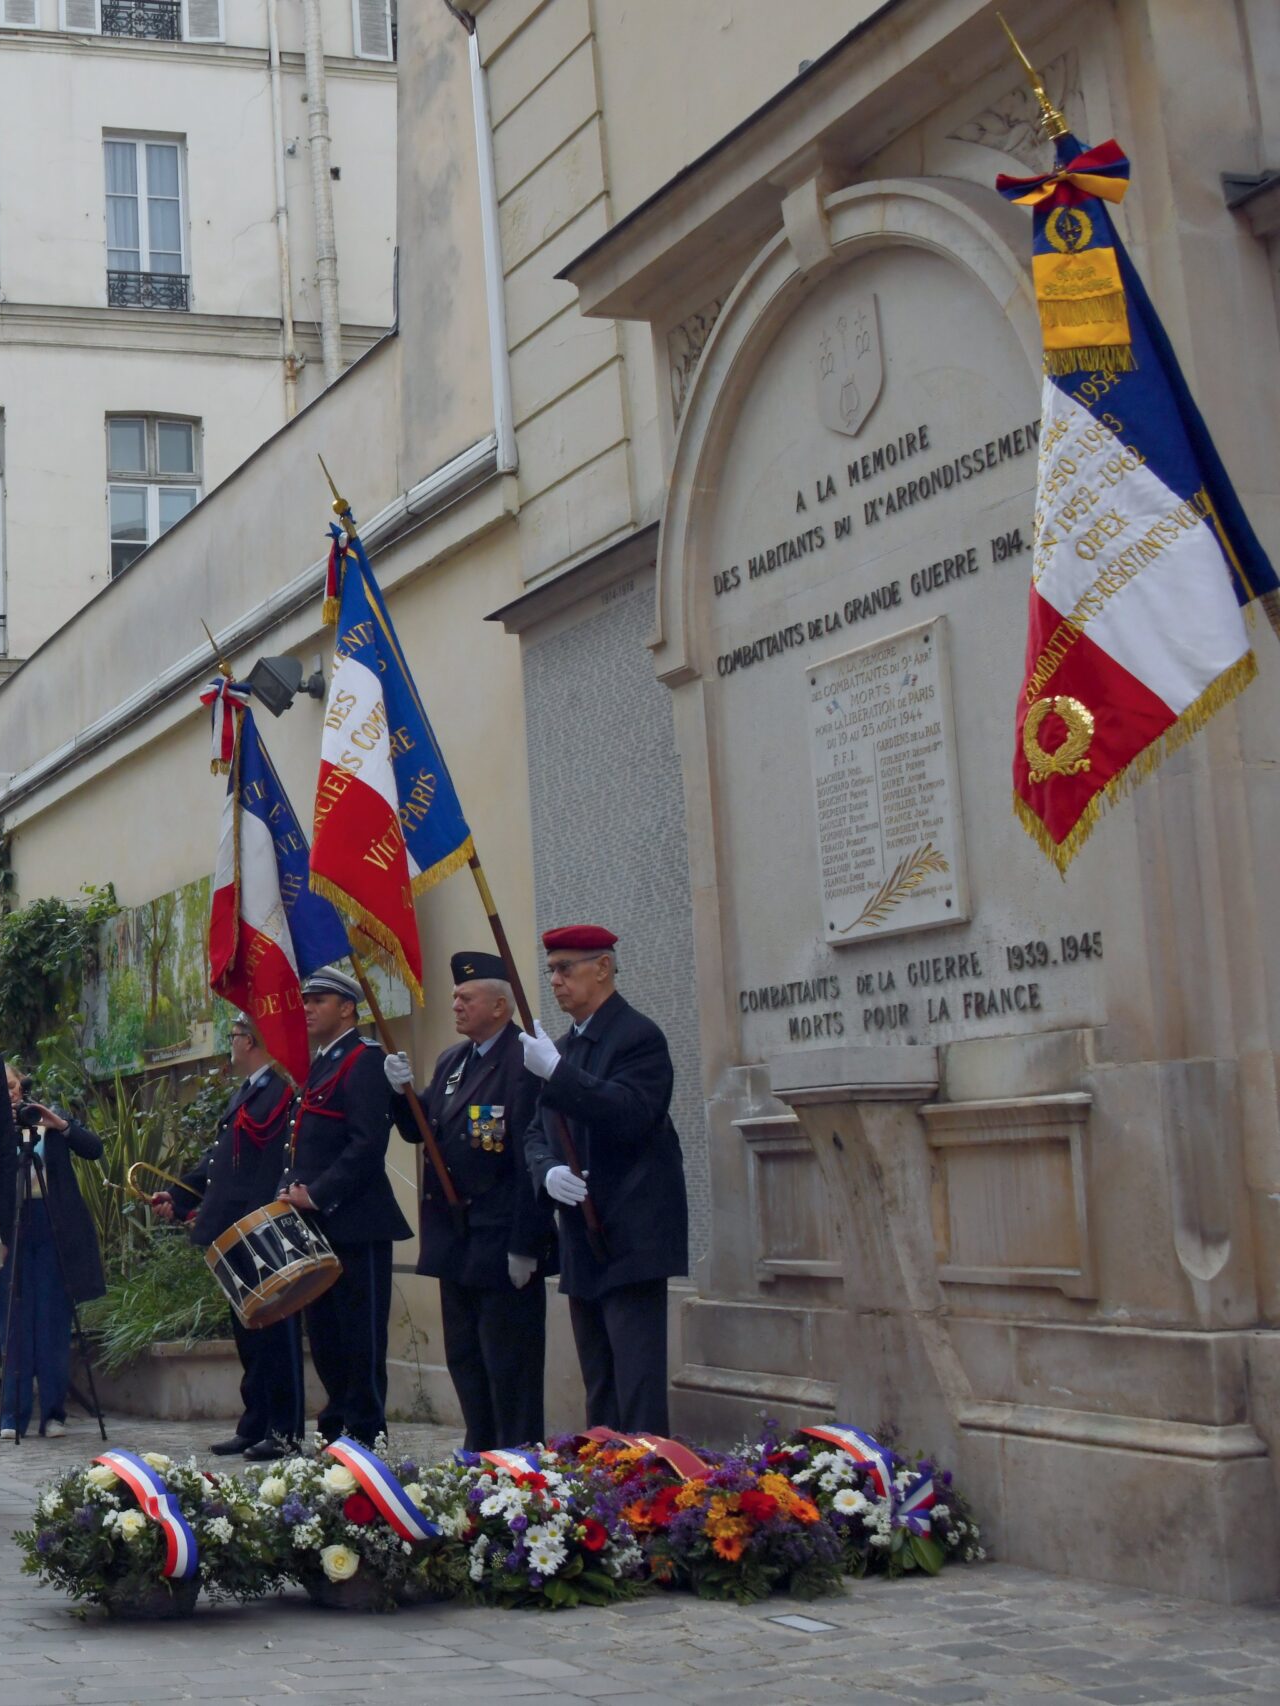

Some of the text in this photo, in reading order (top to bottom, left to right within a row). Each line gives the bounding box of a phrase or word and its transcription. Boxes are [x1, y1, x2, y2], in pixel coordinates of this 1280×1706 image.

[796, 425, 930, 514] A LA MEMOIRE
[713, 566, 741, 597] DES
[748, 526, 826, 580] HABITANTS
[834, 515, 852, 541] DU
[1075, 508, 1130, 561] OPEX
[716, 622, 805, 678] COMBATTANTS
[808, 617, 824, 641] DE
[824, 610, 842, 634] LA
[843, 580, 902, 625] GRANDE
[910, 547, 979, 597] GUERRE
[823, 664, 889, 697] COMBATTANTS
[889, 662, 899, 673] DU
[849, 682, 891, 707] MORTS
[907, 684, 935, 704] PARIS
[324, 689, 357, 731] DES
[838, 732, 847, 745] 19
[849, 730, 860, 741] AU
[861, 722, 875, 737] 25
[899, 707, 922, 725] 1944
[399, 767, 437, 832] PARIS
[739, 975, 840, 1014] COMBATTANTS
[857, 974, 873, 996] DE
[877, 970, 895, 992] LA
[907, 951, 982, 987] GUERRE
[788, 983, 1042, 1041] MORTS POUR LA FRANCE
